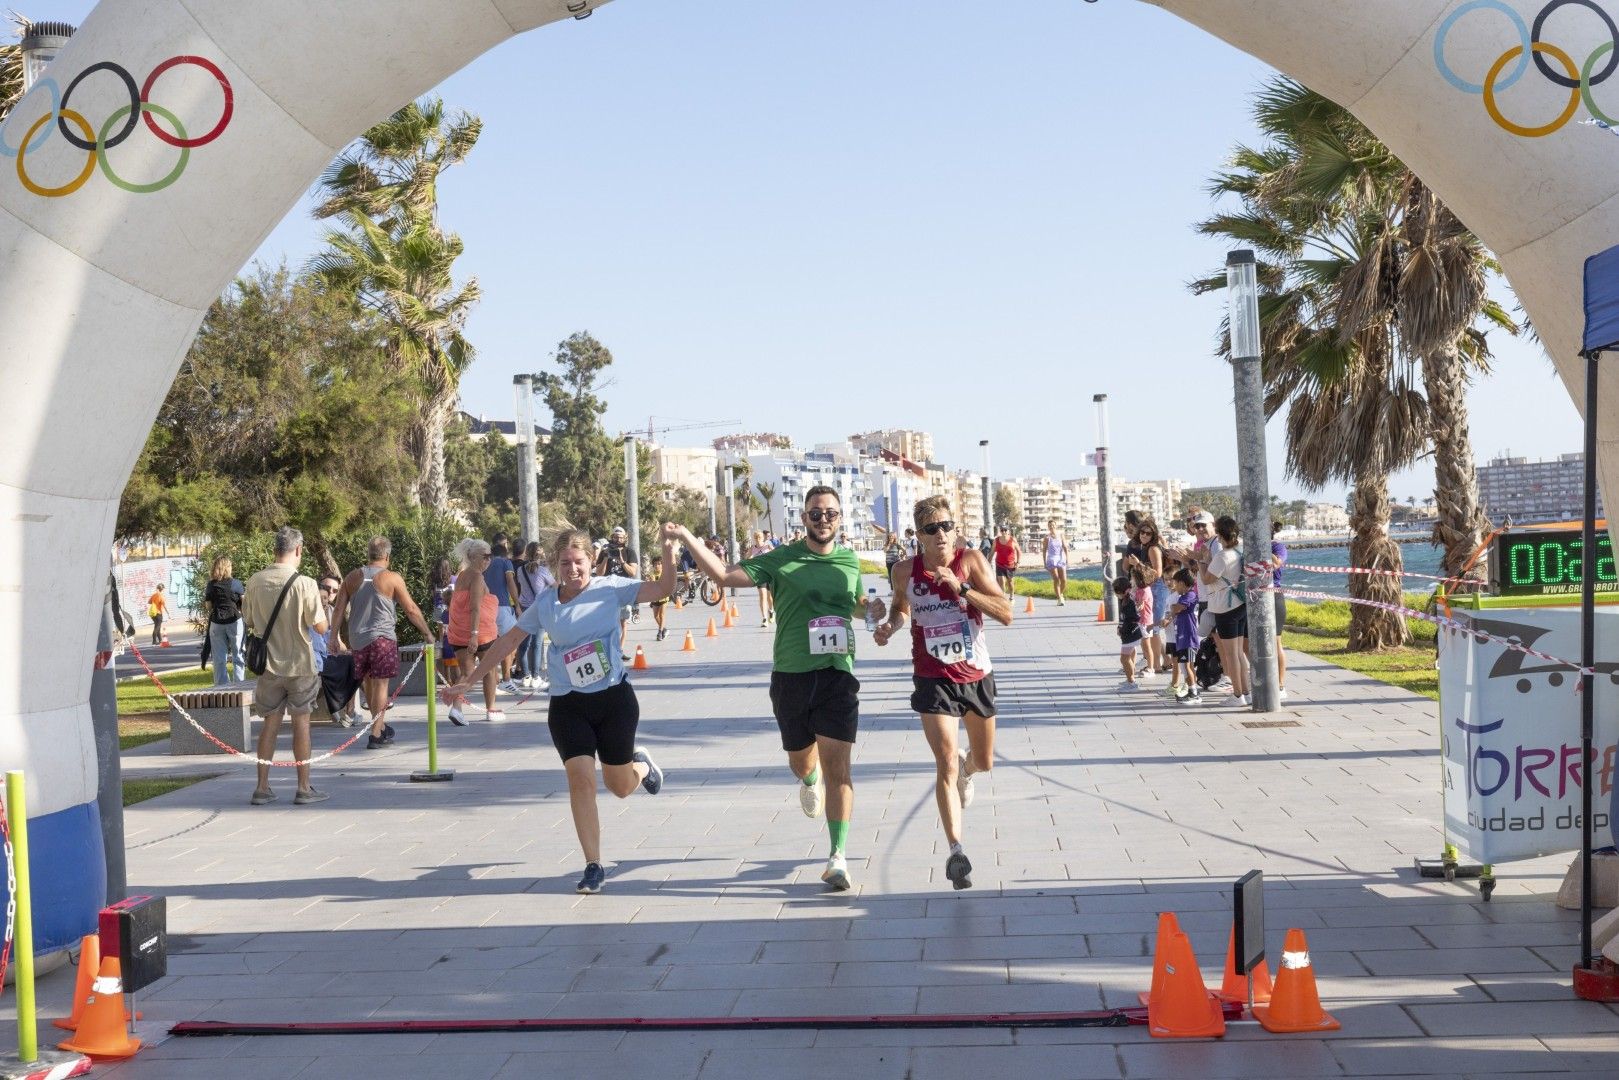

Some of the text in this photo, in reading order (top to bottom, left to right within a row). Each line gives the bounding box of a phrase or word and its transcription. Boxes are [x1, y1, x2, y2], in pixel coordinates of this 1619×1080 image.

[1542, 583, 1618, 593] WWW.GRBROT
[818, 633, 837, 646] 11
[930, 641, 963, 657] 170
[575, 662, 595, 679] 18
[1467, 806, 1545, 832] ciudad
